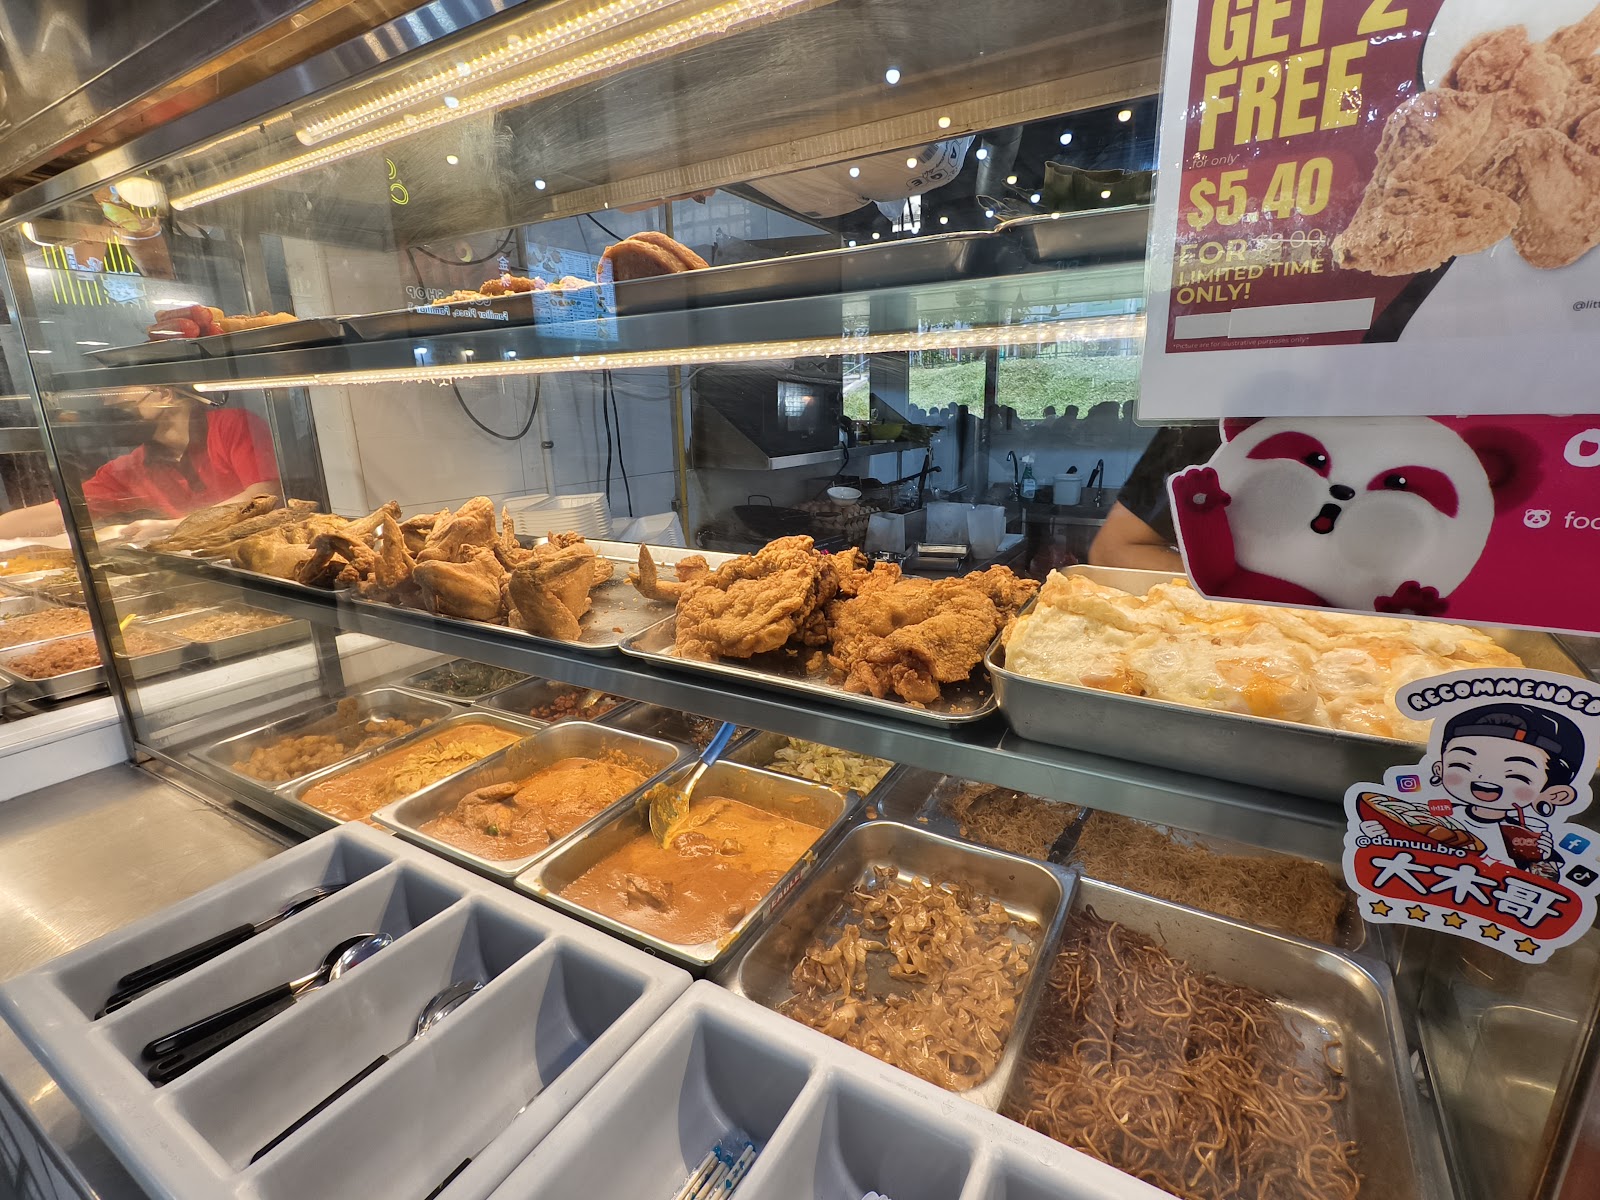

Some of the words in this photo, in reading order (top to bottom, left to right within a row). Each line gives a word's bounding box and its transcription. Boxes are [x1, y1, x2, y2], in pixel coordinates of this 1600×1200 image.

[1198, 40, 1368, 151] FREE
[1187, 157, 1333, 231] $5.40
[1179, 239, 1247, 267] FOR
[1179, 264, 1264, 286] LIMITED
[1271, 258, 1324, 277] TIME
[1176, 283, 1250, 305] ONLY!
[1408, 678, 1600, 716] RECOMMENDED
[1355, 835, 1467, 858] @damuu.bro
[1369, 852, 1569, 927] 大木哥
